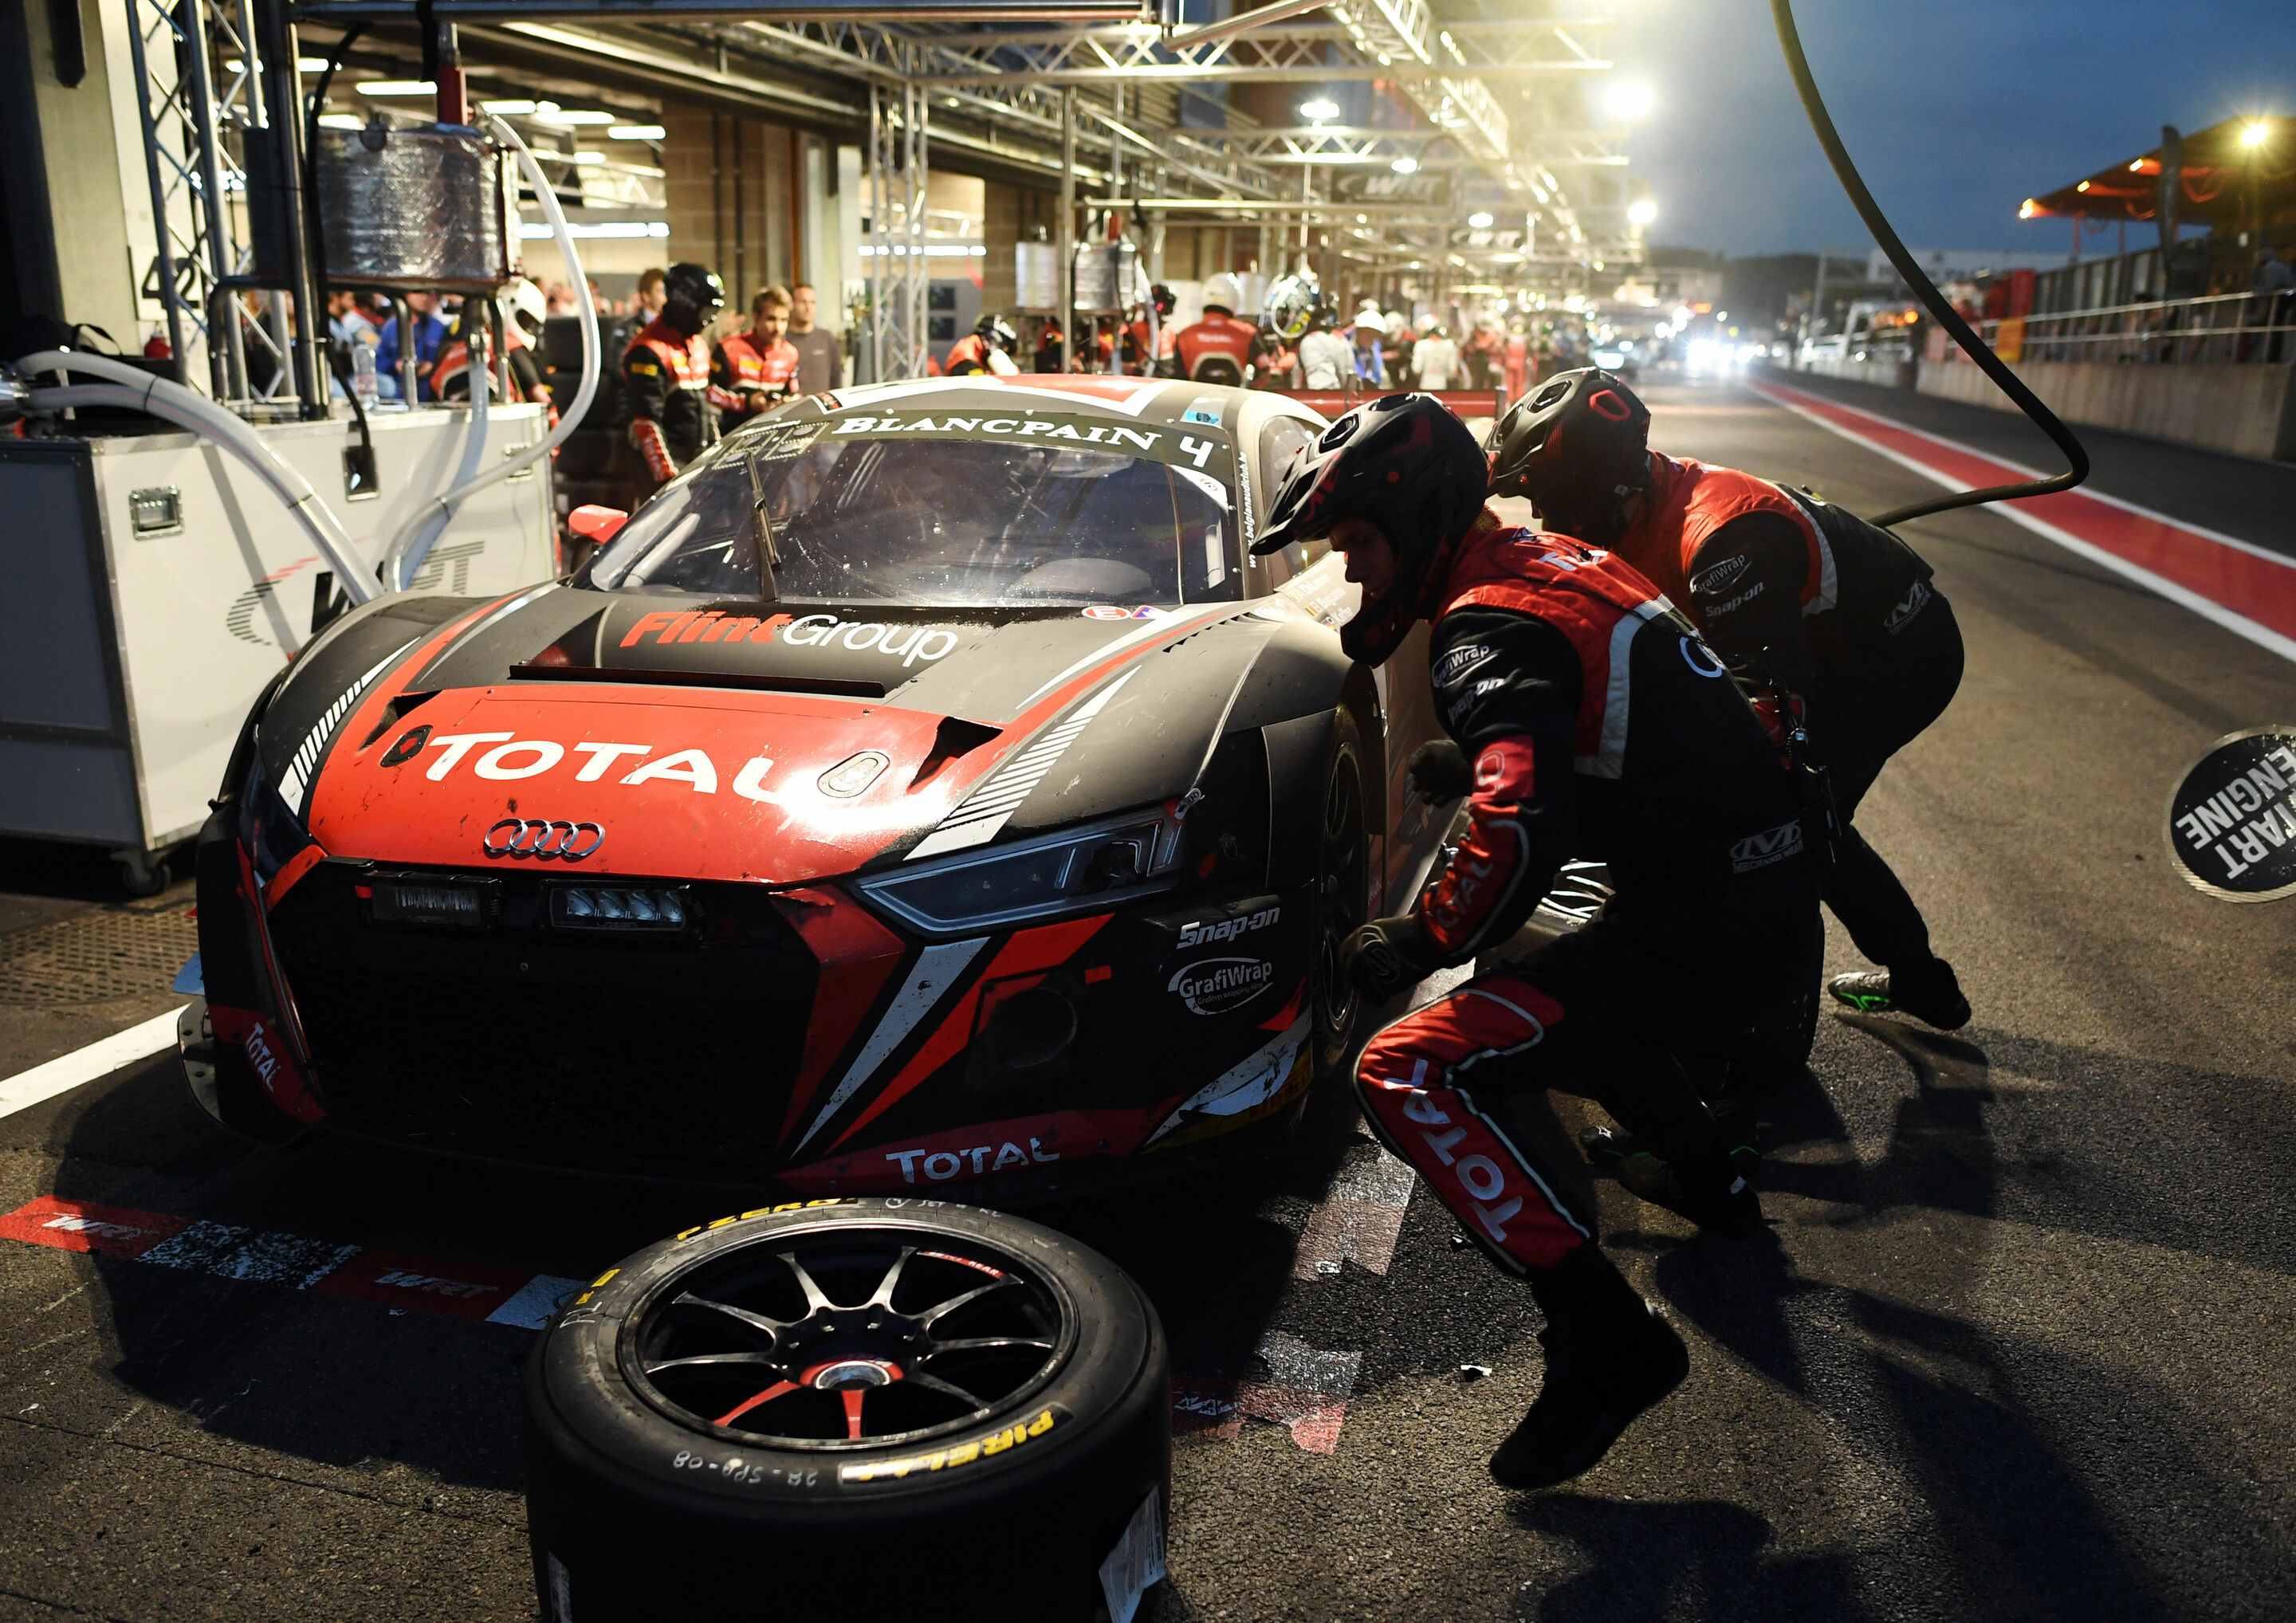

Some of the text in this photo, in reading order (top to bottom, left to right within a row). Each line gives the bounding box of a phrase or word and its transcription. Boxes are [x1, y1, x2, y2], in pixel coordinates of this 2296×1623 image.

[831, 417, 1162, 450] BLANCPAIN
[1180, 435, 1214, 468] 4
[1705, 581, 1765, 617] Snap-on
[427, 731, 785, 805] TOTAL
[2175, 745, 2296, 851] ENGINE
[2207, 789, 2296, 880] TART
[1176, 907, 1280, 949] Snap-on
[1179, 961, 1272, 998] GrafiWrap
[246, 1022, 281, 1093] TOTAL
[886, 1137, 1060, 1184] TOTAL
[1383, 1059, 1523, 1243] TOTAL
[858, 1410, 1055, 1481] PIREL
